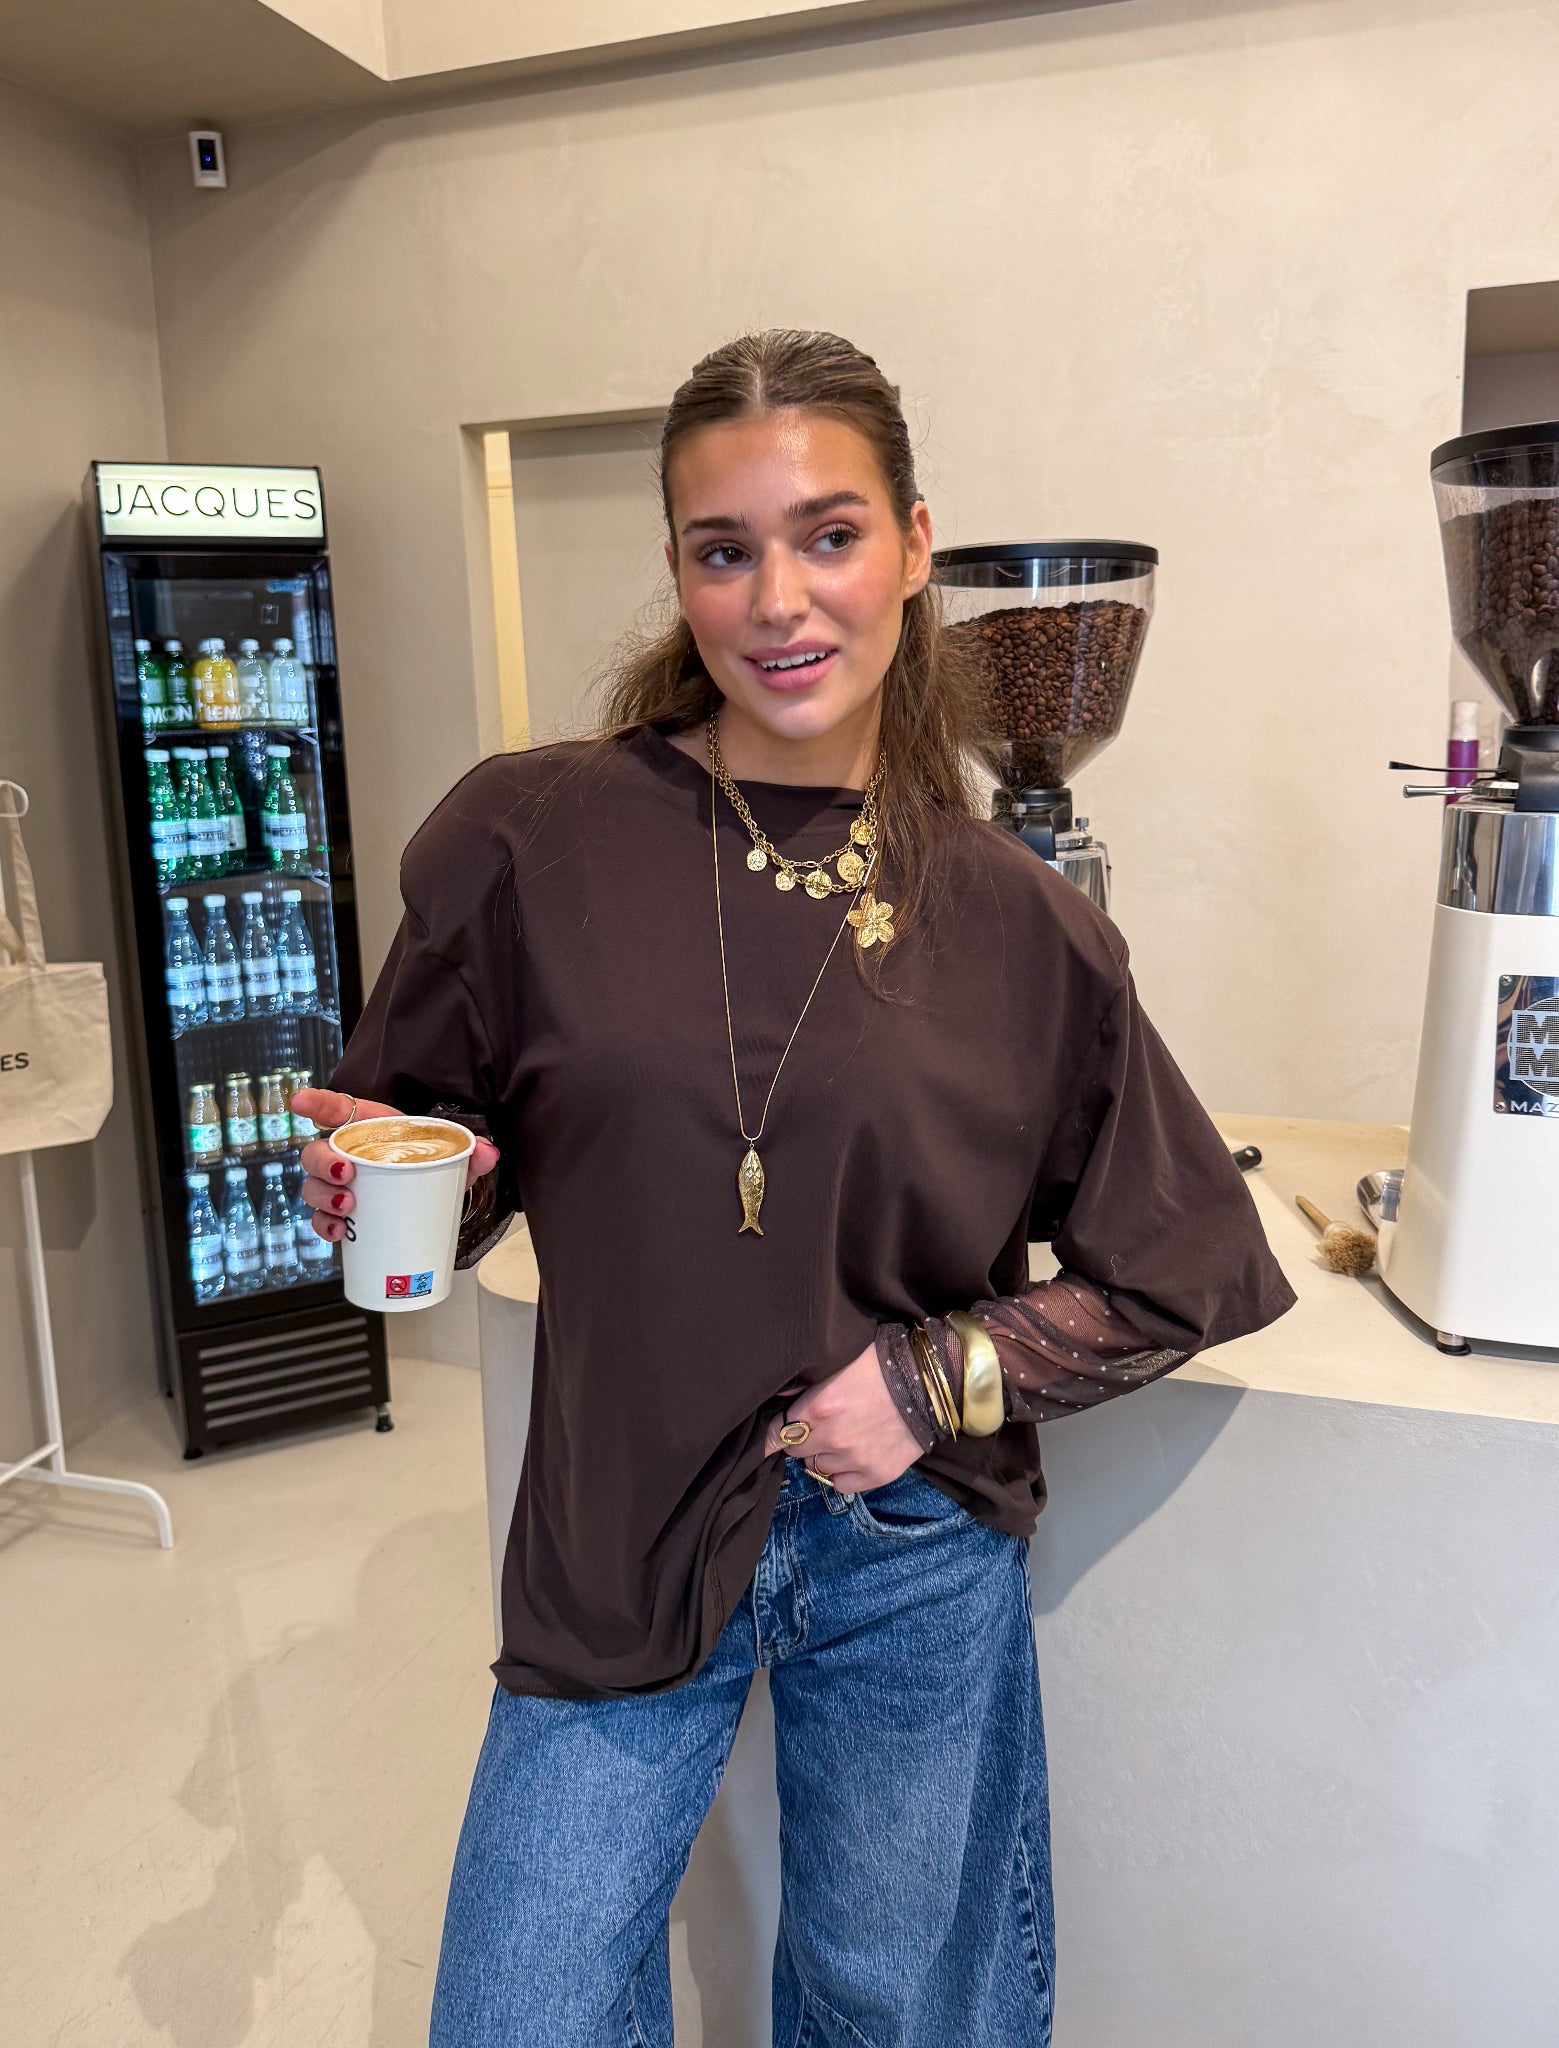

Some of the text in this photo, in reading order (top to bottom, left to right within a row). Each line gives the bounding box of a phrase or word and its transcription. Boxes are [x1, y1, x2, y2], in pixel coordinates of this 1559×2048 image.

[105, 484, 317, 519] JACQUES
[1, 1052, 29, 1072] ES
[1510, 1100, 1559, 1113] MAZ
